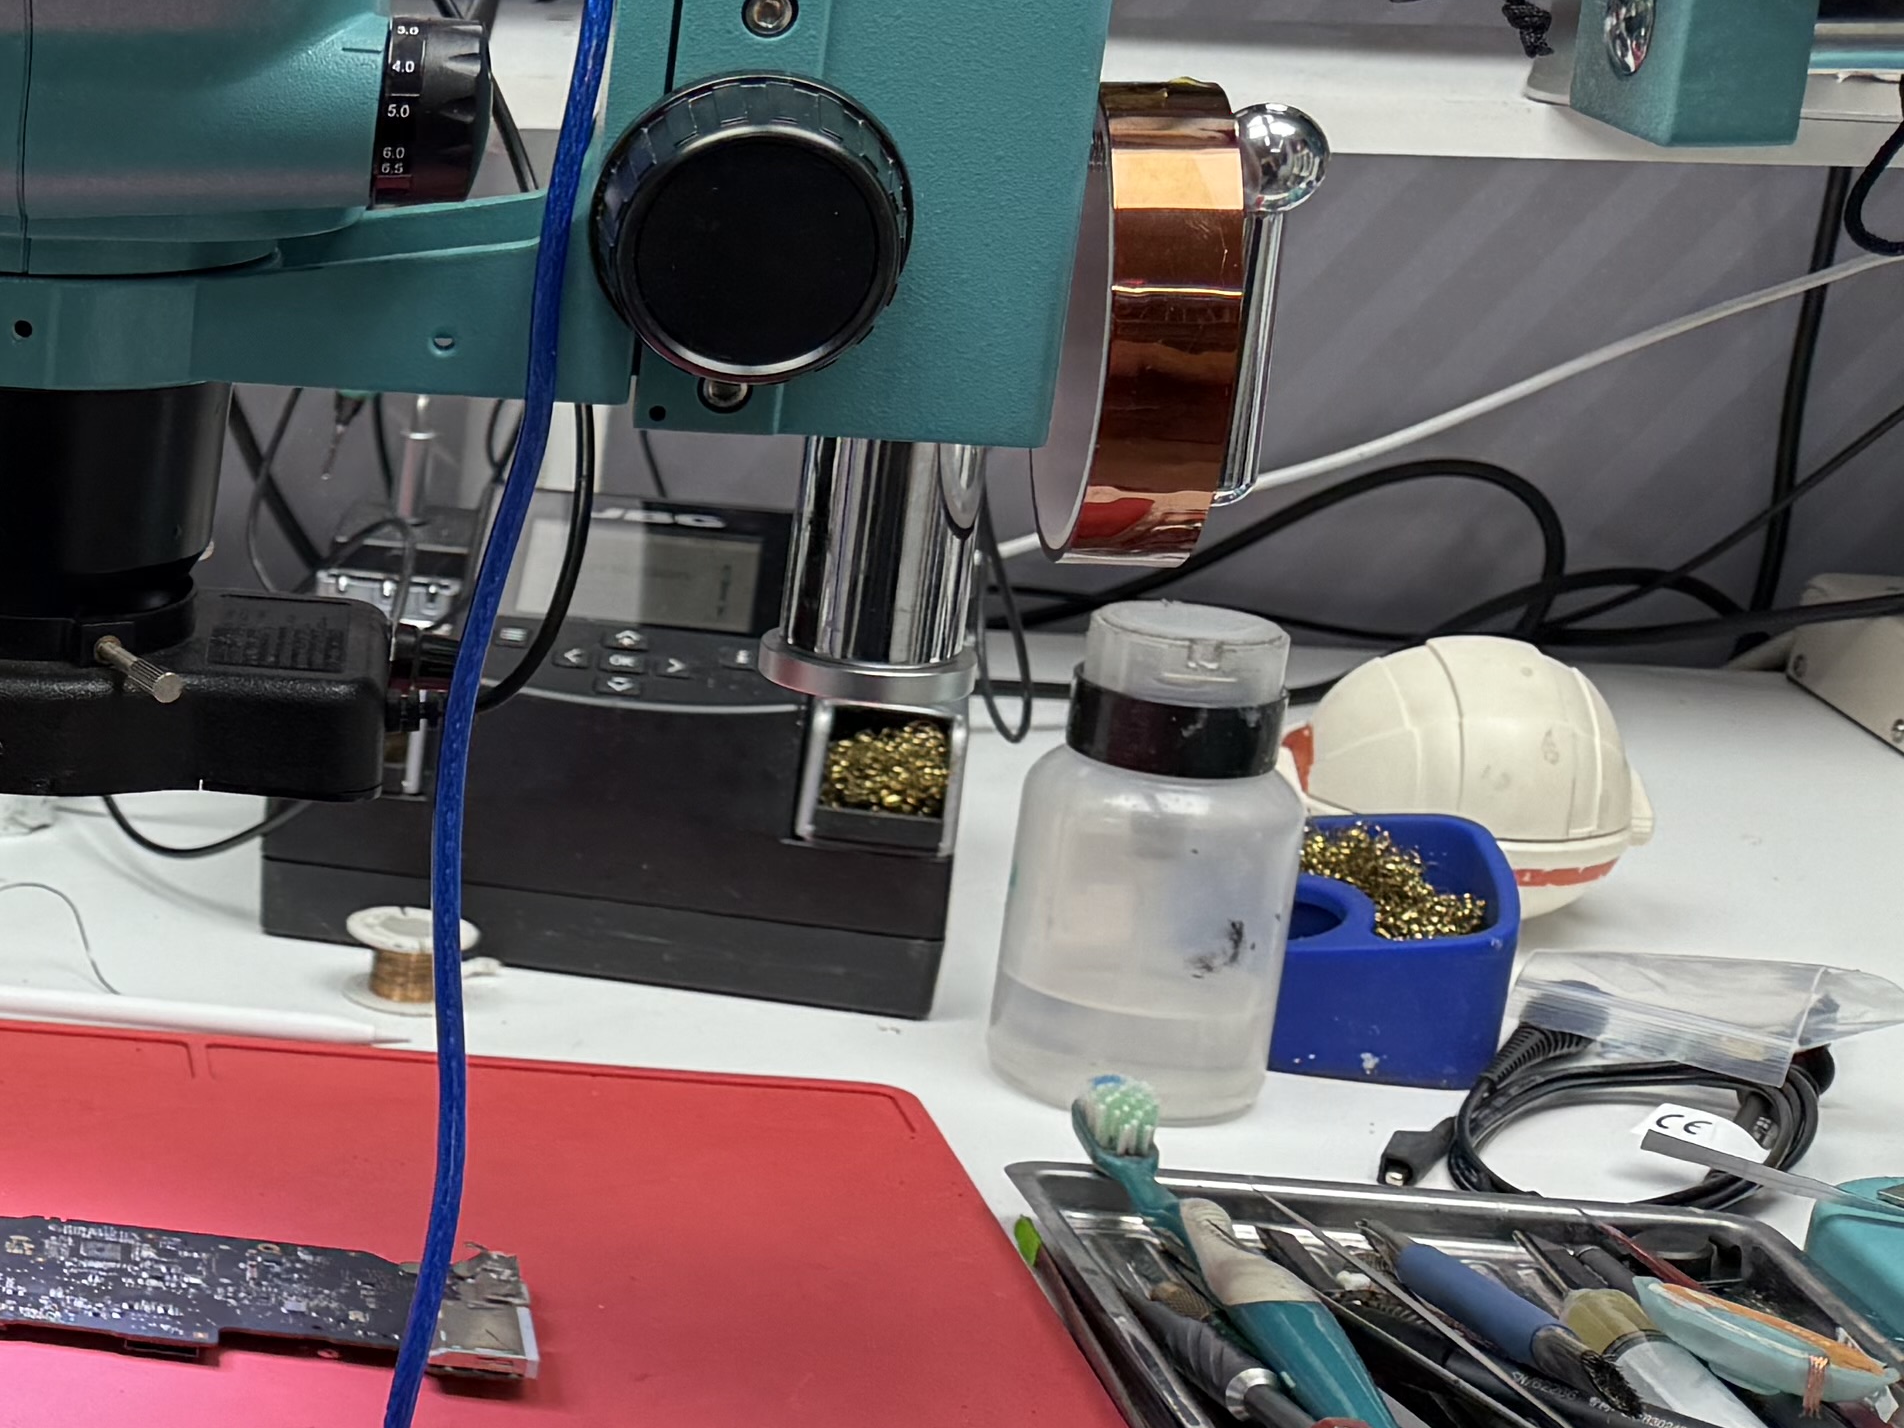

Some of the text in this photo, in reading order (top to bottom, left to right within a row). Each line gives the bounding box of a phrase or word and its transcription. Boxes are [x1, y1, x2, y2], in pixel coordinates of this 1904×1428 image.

[392, 60, 414, 72] 4.0
[388, 104, 409, 118] 5.0
[383, 147, 405, 159] 6.0
[382, 163, 403, 174] 6.5
[1655, 1113, 1713, 1136] CE
